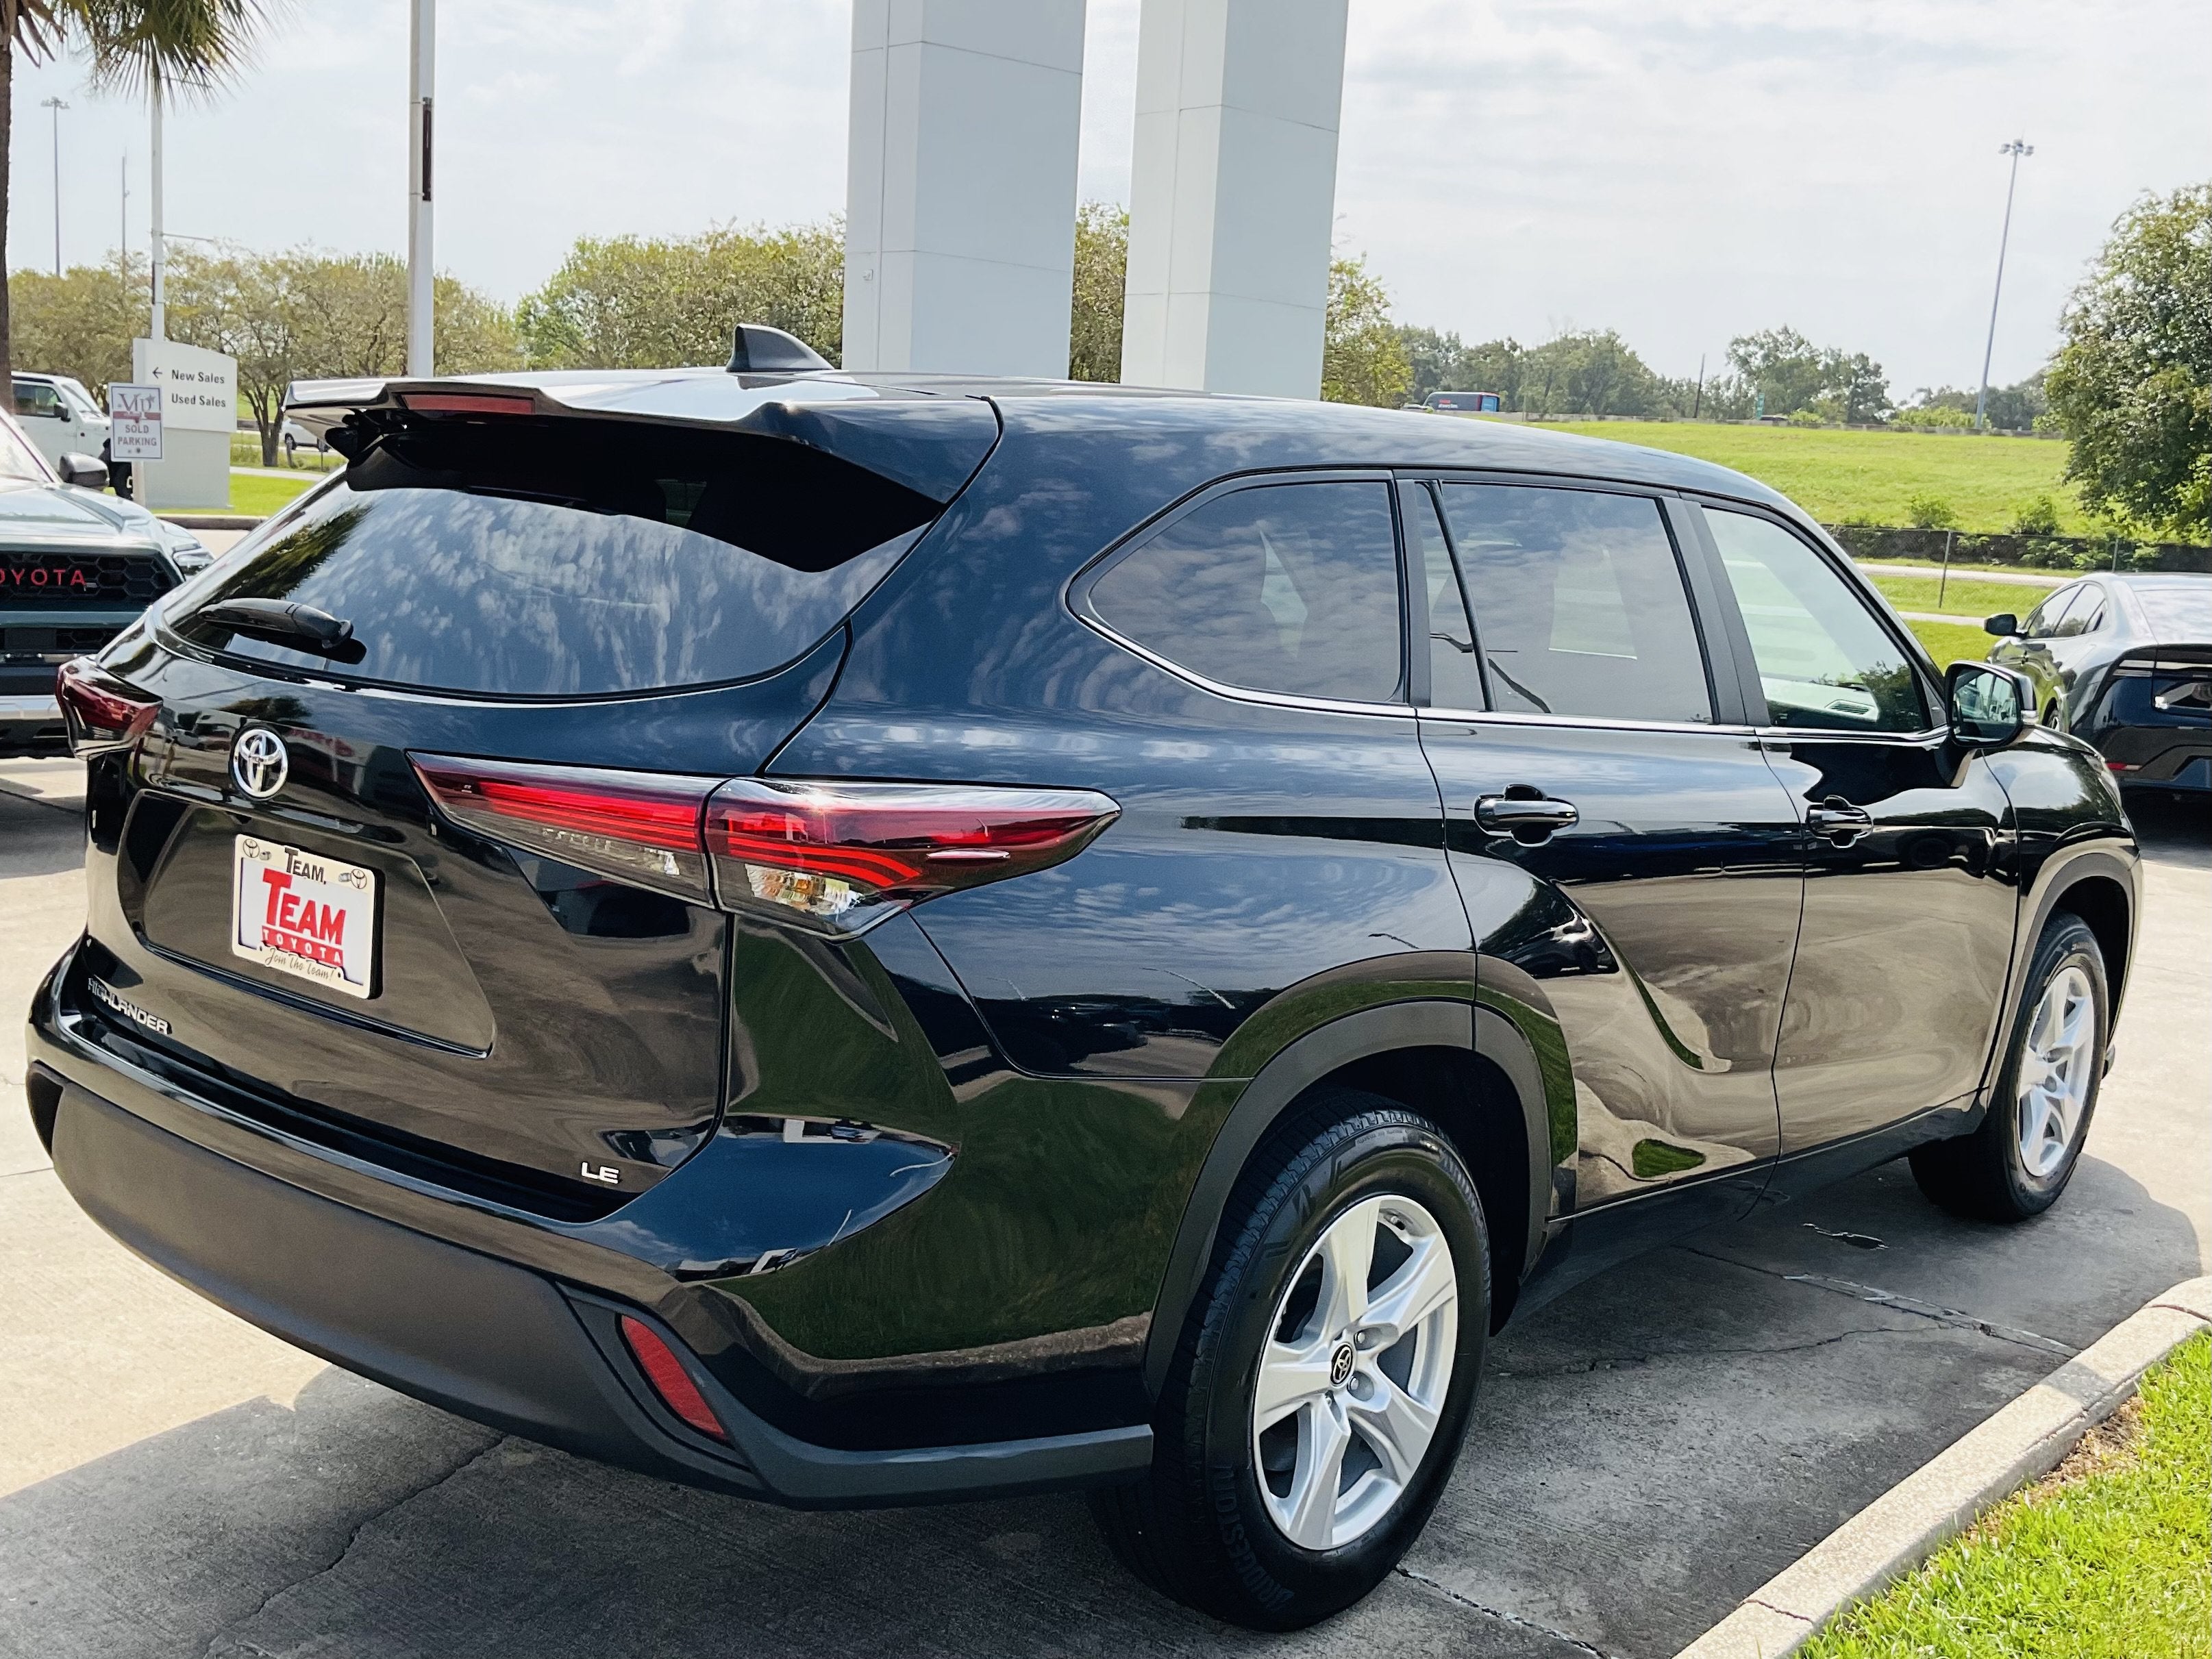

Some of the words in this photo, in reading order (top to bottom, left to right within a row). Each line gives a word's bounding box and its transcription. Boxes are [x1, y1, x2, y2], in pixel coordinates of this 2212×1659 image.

[172, 370, 195, 382] New
[198, 372, 225, 384] Sales
[172, 394, 196, 405] Used
[199, 396, 226, 408] Sales
[125, 424, 149, 434] SOLD
[118, 436, 157, 447] PARKING
[262, 868, 347, 945] TEAM
[262, 929, 342, 964] TOYOTA
[264, 947, 286, 965] Join
[88, 977, 169, 1035] HIGHLANDER
[581, 1161, 619, 1184] LE
